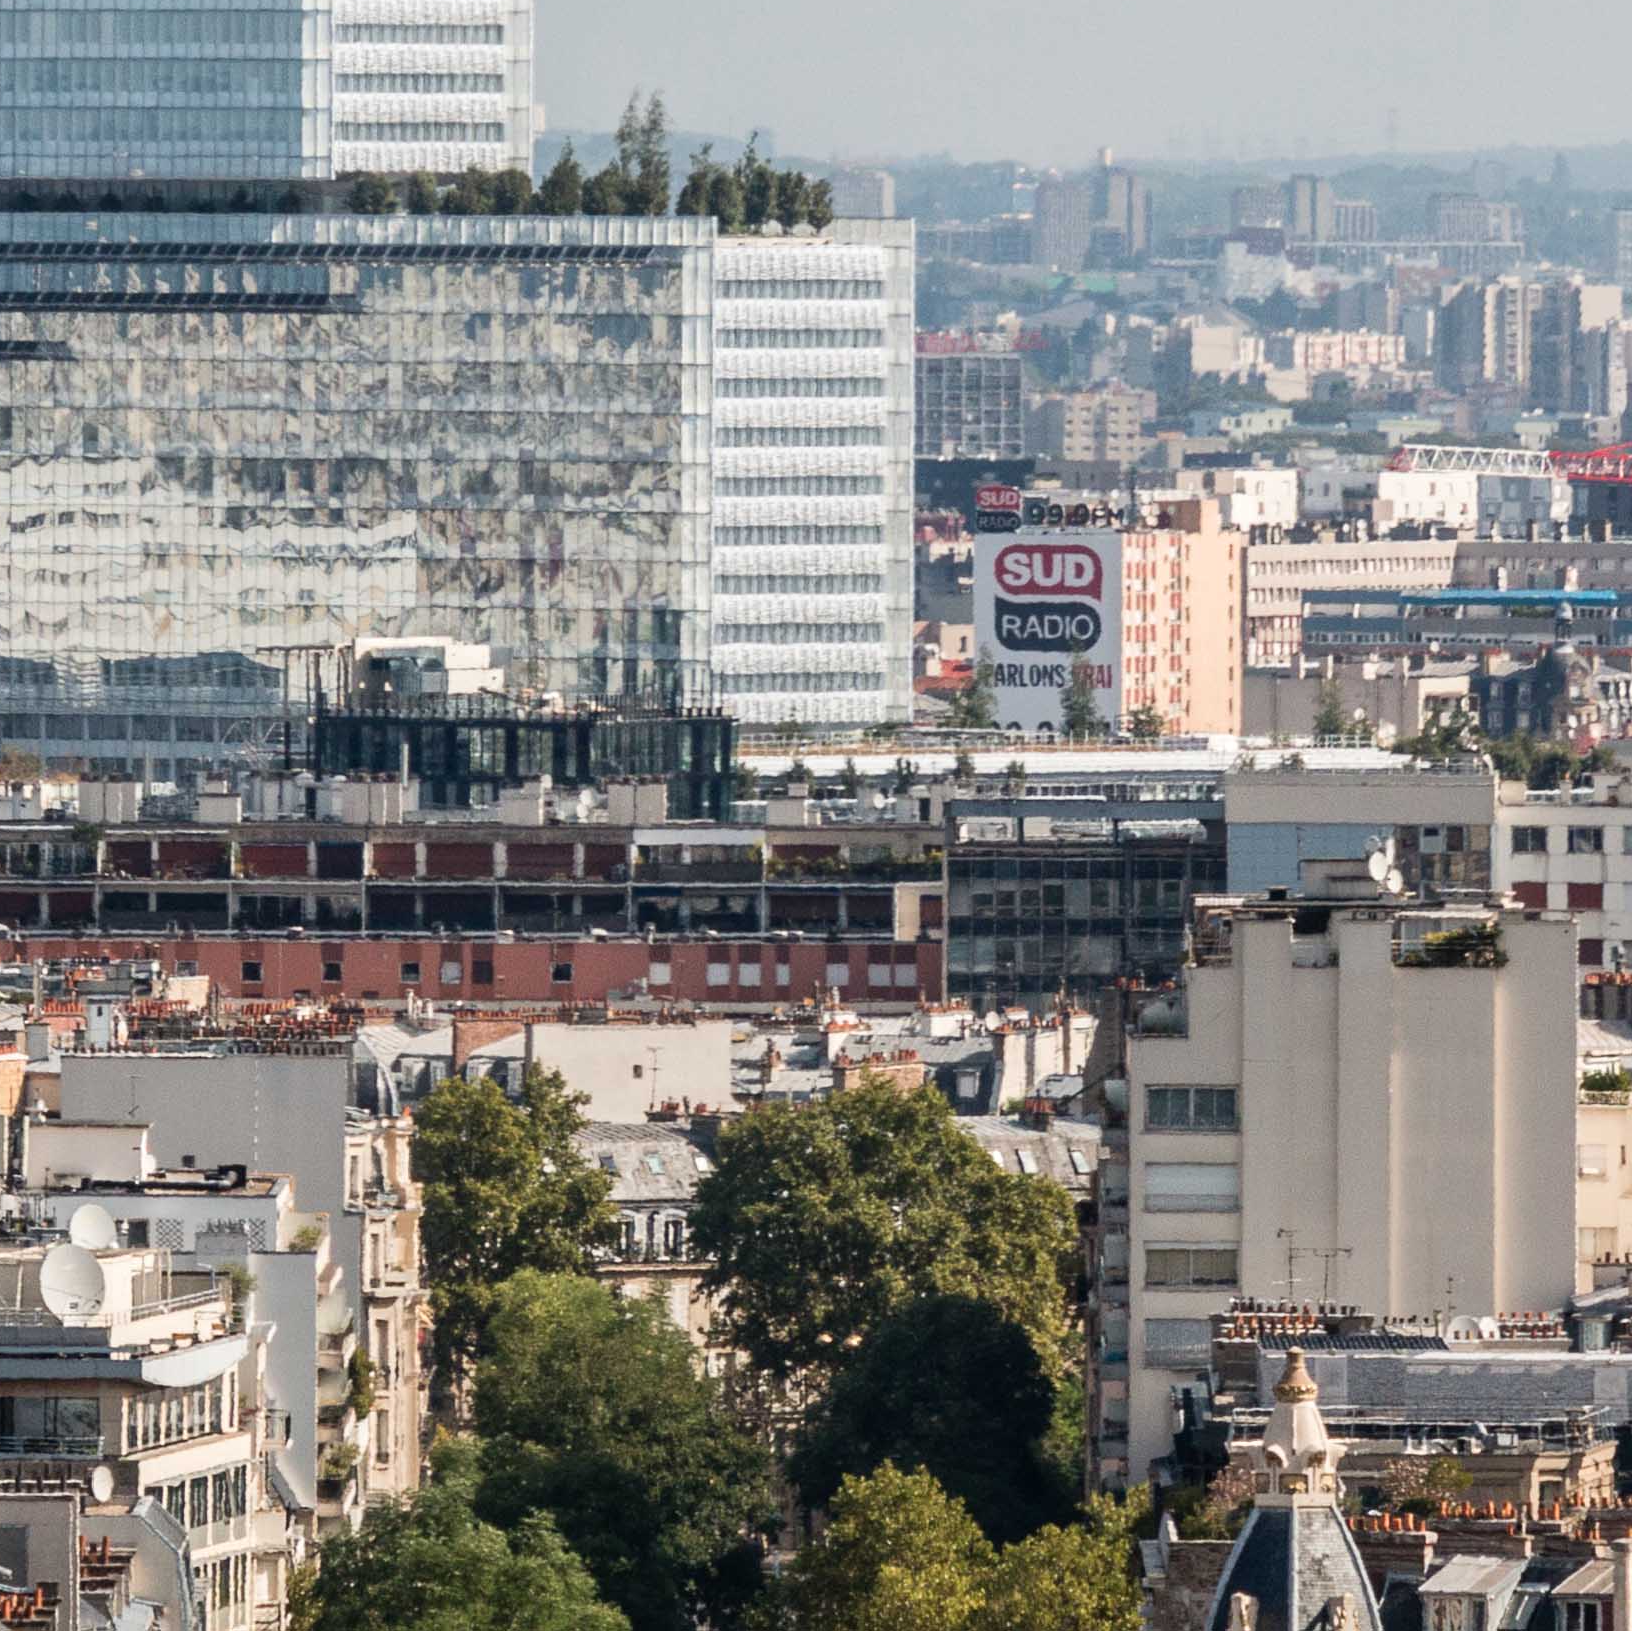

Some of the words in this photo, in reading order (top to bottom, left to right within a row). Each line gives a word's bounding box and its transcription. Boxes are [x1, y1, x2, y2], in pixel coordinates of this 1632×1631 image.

[980, 491, 1017, 506] SUD
[978, 515, 1019, 528] RADIO
[1002, 552, 1094, 588] SUD
[1002, 614, 1094, 641] RADIO
[985, 663, 1066, 688] ARLONS
[1072, 663, 1112, 688] RAI
